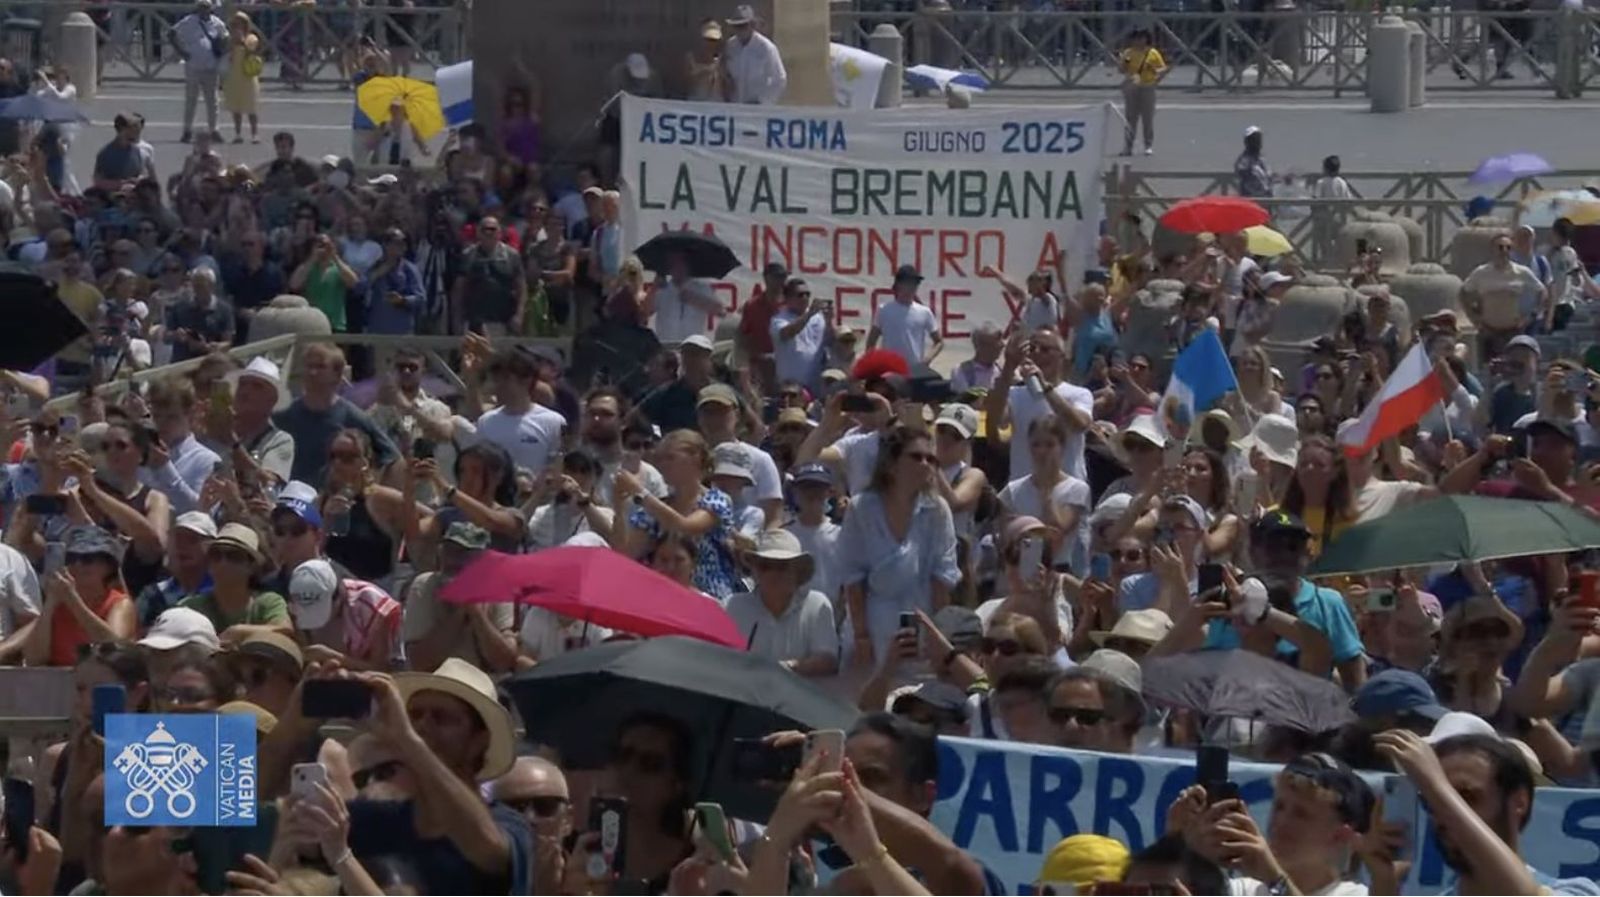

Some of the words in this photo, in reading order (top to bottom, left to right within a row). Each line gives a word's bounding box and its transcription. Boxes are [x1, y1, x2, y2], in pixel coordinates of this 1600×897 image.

[903, 130, 986, 153] GIUGNO
[1001, 121, 1086, 153] 2025
[639, 161, 696, 211] LA
[720, 164, 808, 214] VAL
[831, 168, 1083, 220] BREMBANA
[751, 224, 1006, 278] INCONTRO
